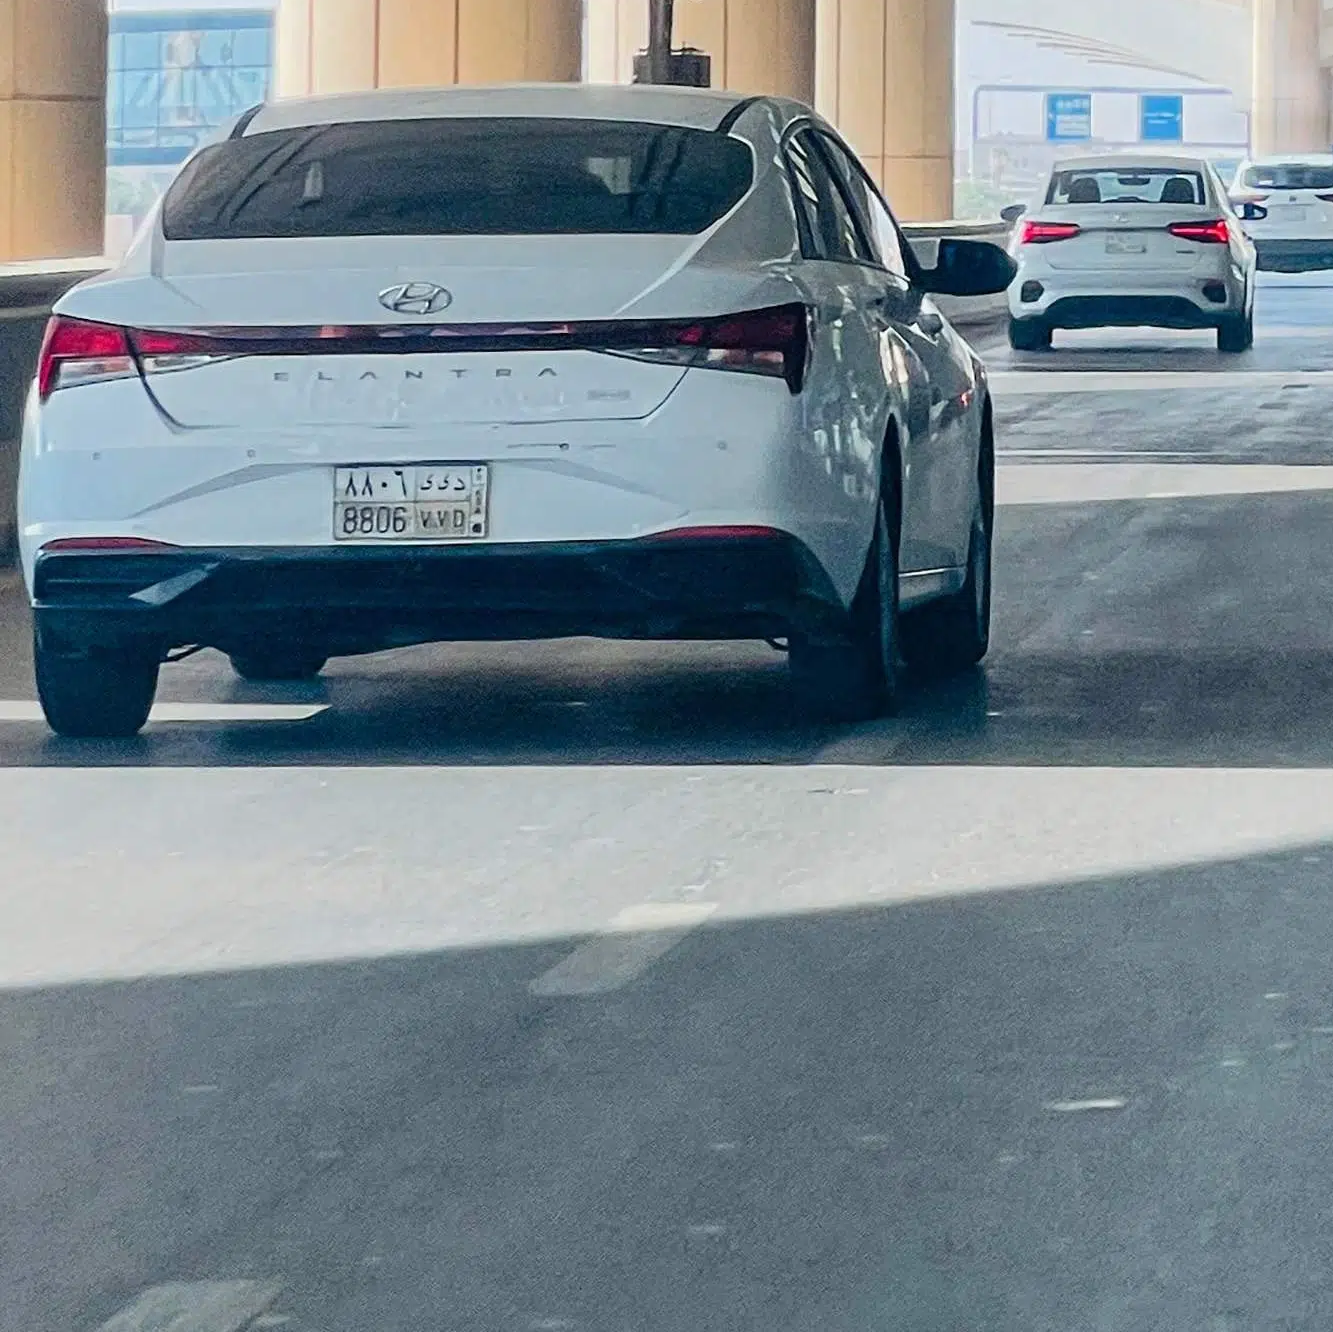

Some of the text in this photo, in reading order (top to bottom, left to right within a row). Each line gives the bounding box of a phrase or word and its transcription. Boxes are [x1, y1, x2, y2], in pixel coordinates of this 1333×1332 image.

[273, 367, 558, 381] ELANTRA
[342, 505, 466, 534] 8806 VVD
